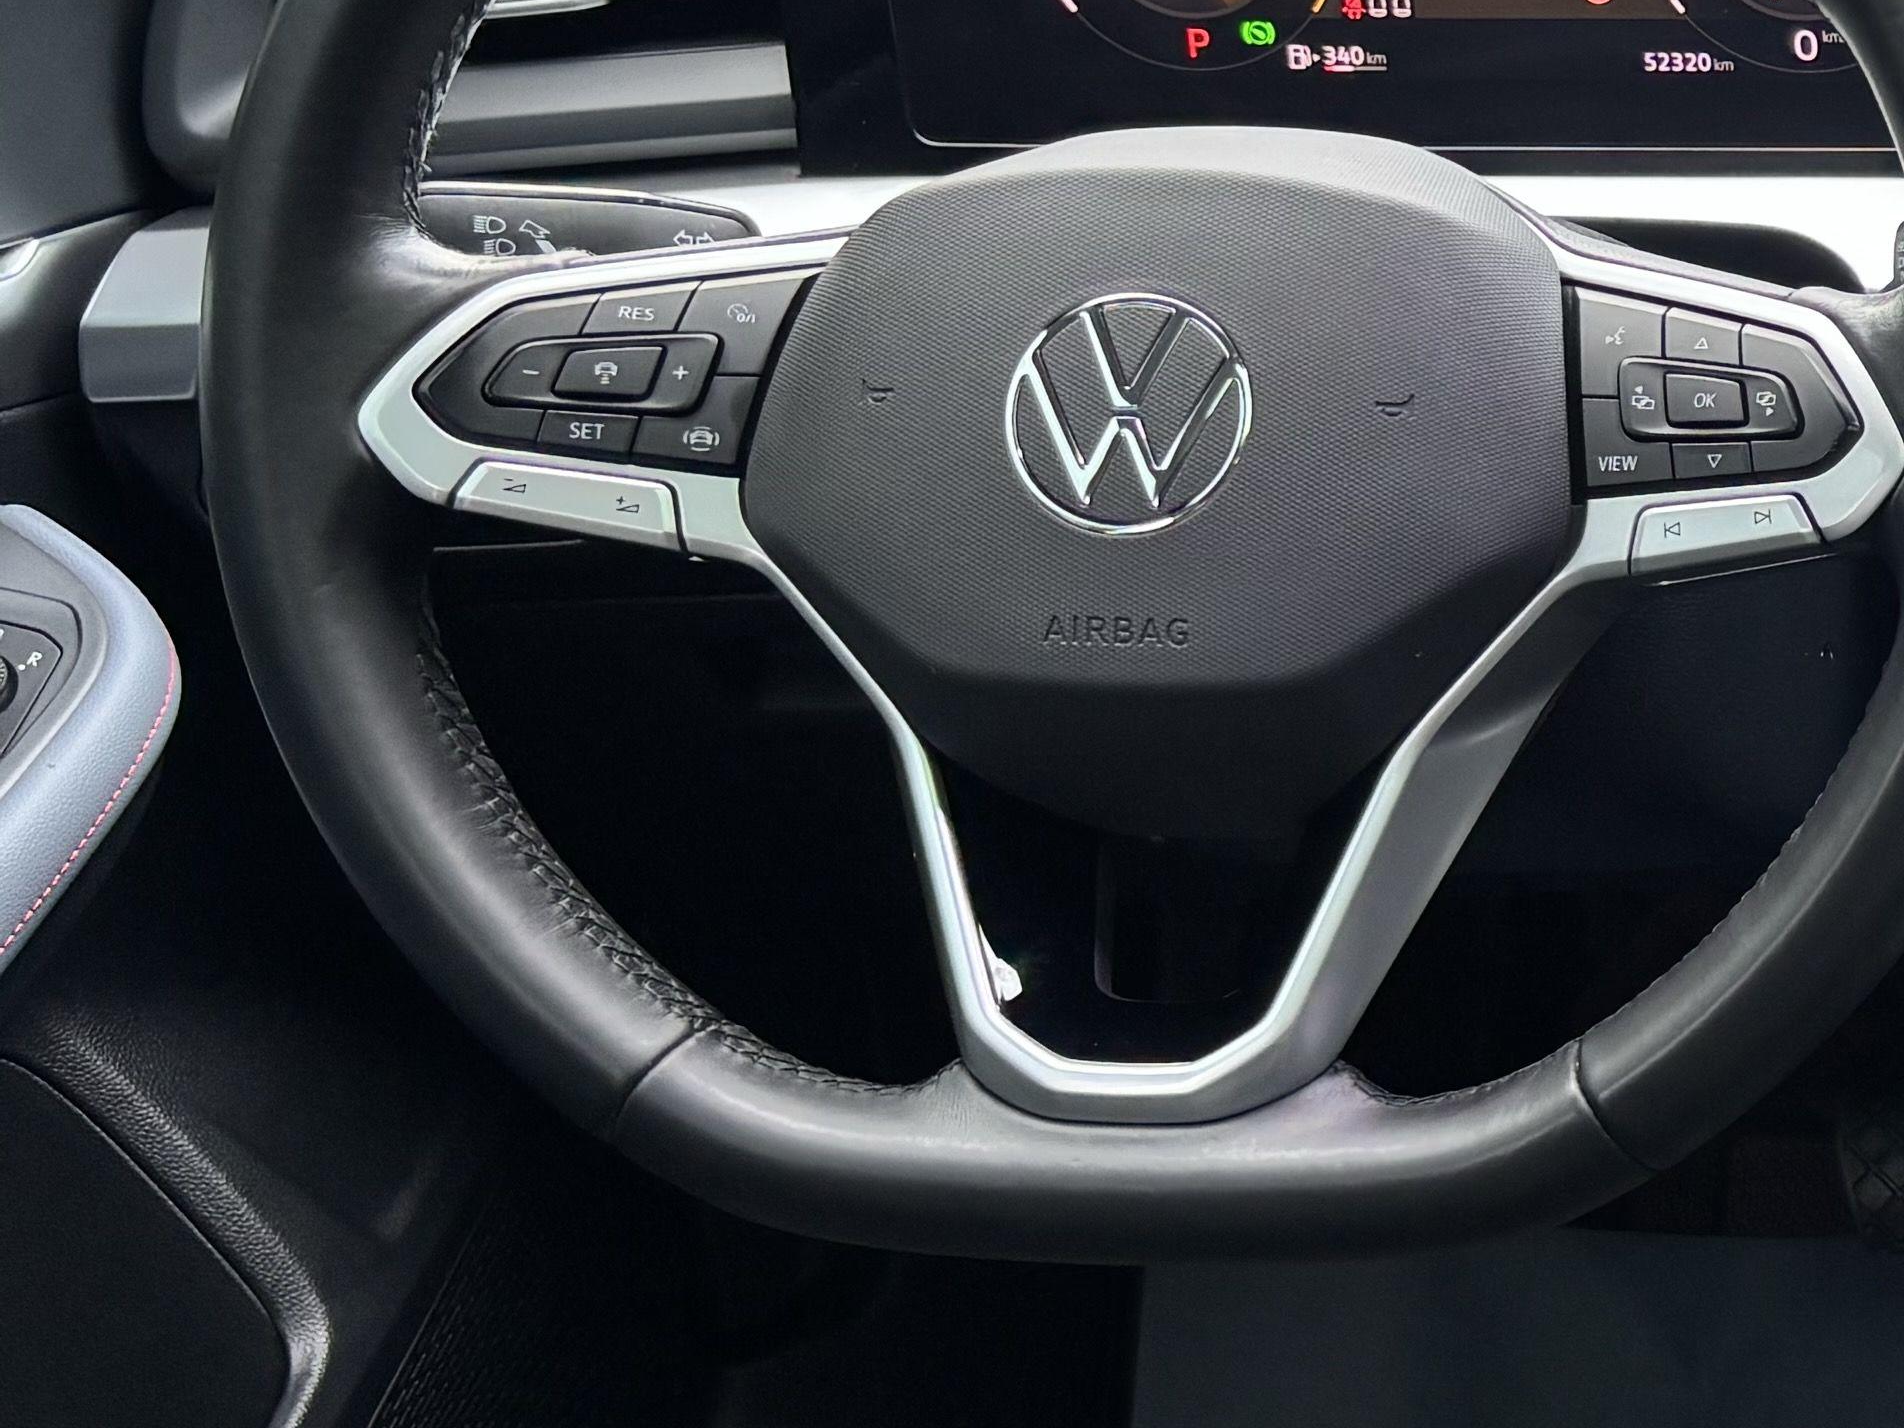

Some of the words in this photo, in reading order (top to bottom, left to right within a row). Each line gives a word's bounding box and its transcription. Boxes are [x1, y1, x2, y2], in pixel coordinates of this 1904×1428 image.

[1186, 28, 1210, 58] P
[1794, 29, 1818, 61] 0
[617, 305, 655, 322] RES
[1693, 392, 1718, 408] OK
[569, 421, 605, 440] SET
[1598, 455, 1638, 472] VIEW
[1043, 614, 1190, 648] AIRBAG
